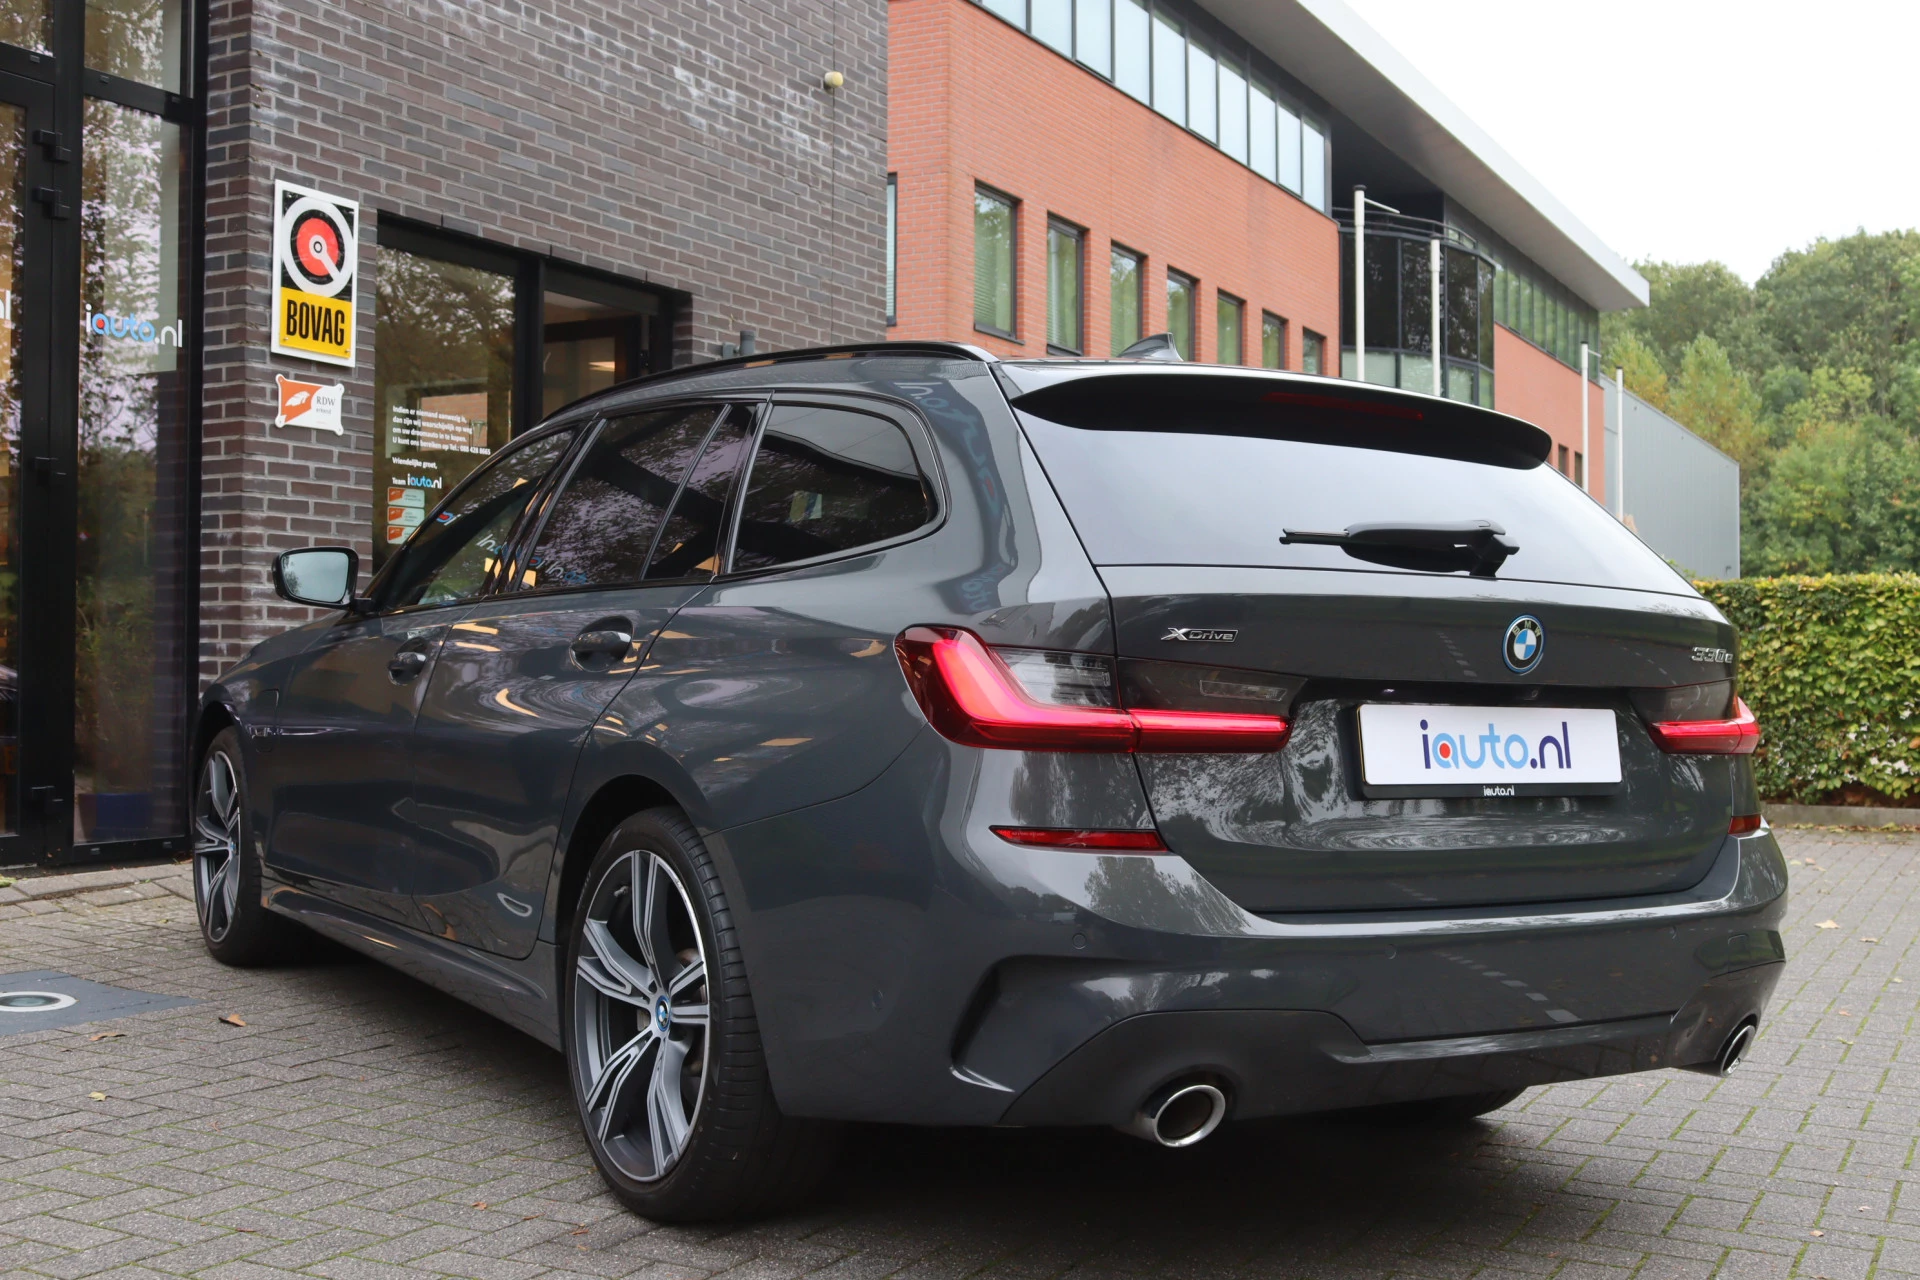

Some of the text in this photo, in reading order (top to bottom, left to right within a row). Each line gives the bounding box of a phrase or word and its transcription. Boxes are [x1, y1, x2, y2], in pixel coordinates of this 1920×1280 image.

[85, 303, 183, 348] iauto.nl
[286, 299, 345, 347] BOVAG
[316, 396, 336, 406] RDW
[392, 404, 409, 414] Indien
[416, 408, 438, 419] niemand
[439, 412, 461, 424] aanwezig
[392, 415, 403, 423] dan
[403, 417, 413, 426] zijn
[413, 418, 421, 428] wij
[455, 425, 462, 433] op
[462, 426, 473, 435] weg
[410, 428, 438, 439] droomauto
[398, 436, 410, 445] kunt
[410, 439, 420, 447] ons
[420, 439, 441, 449] bereiken
[442, 443, 449, 451] op
[392, 456, 422, 468] Vriendelijke
[392, 473, 442, 489] Team iauto.nl
[1691, 646, 1734, 664] 330e
[1419, 719, 1572, 770] iauto.nl
[1483, 785, 1515, 797] iauto.nl
